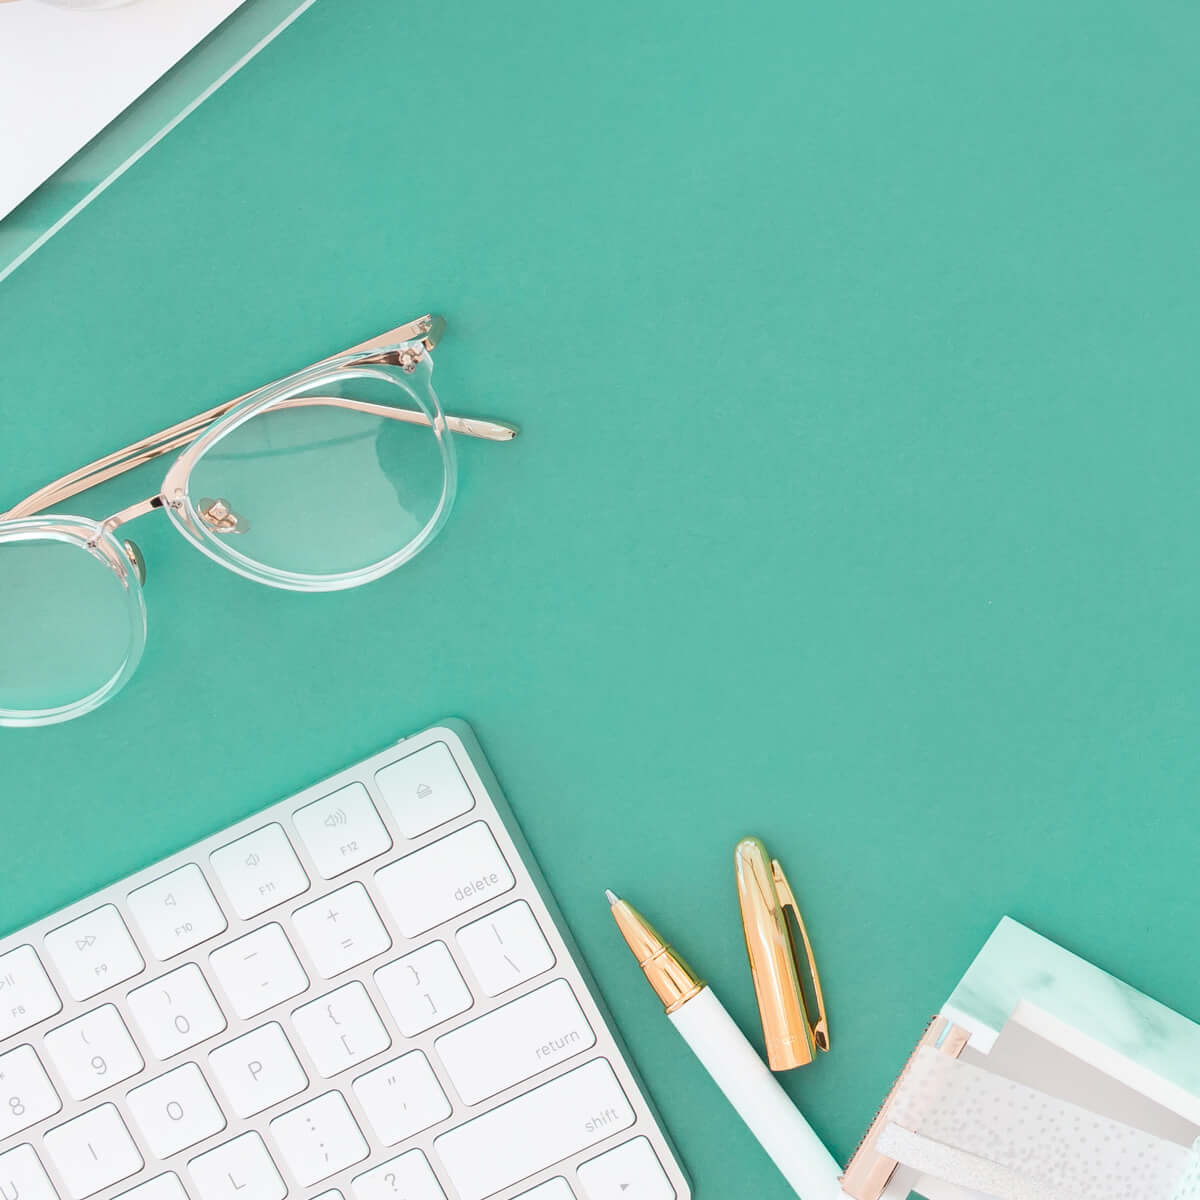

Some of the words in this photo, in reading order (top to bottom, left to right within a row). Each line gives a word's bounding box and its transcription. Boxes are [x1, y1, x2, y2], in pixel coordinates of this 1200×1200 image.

[339, 840, 360, 857] F12
[258, 880, 277, 897] F11
[454, 872, 499, 901] delete
[174, 922, 194, 937] F10
[93, 962, 108, 977] F9
[10, 1004, 27, 1019] F8
[535, 1030, 581, 1059] return
[90, 1055, 108, 1076] 9
[247, 1060, 264, 1083] P
[7, 1095, 26, 1117] 8
[584, 1108, 619, 1132] shift
[227, 1171, 248, 1191] L
